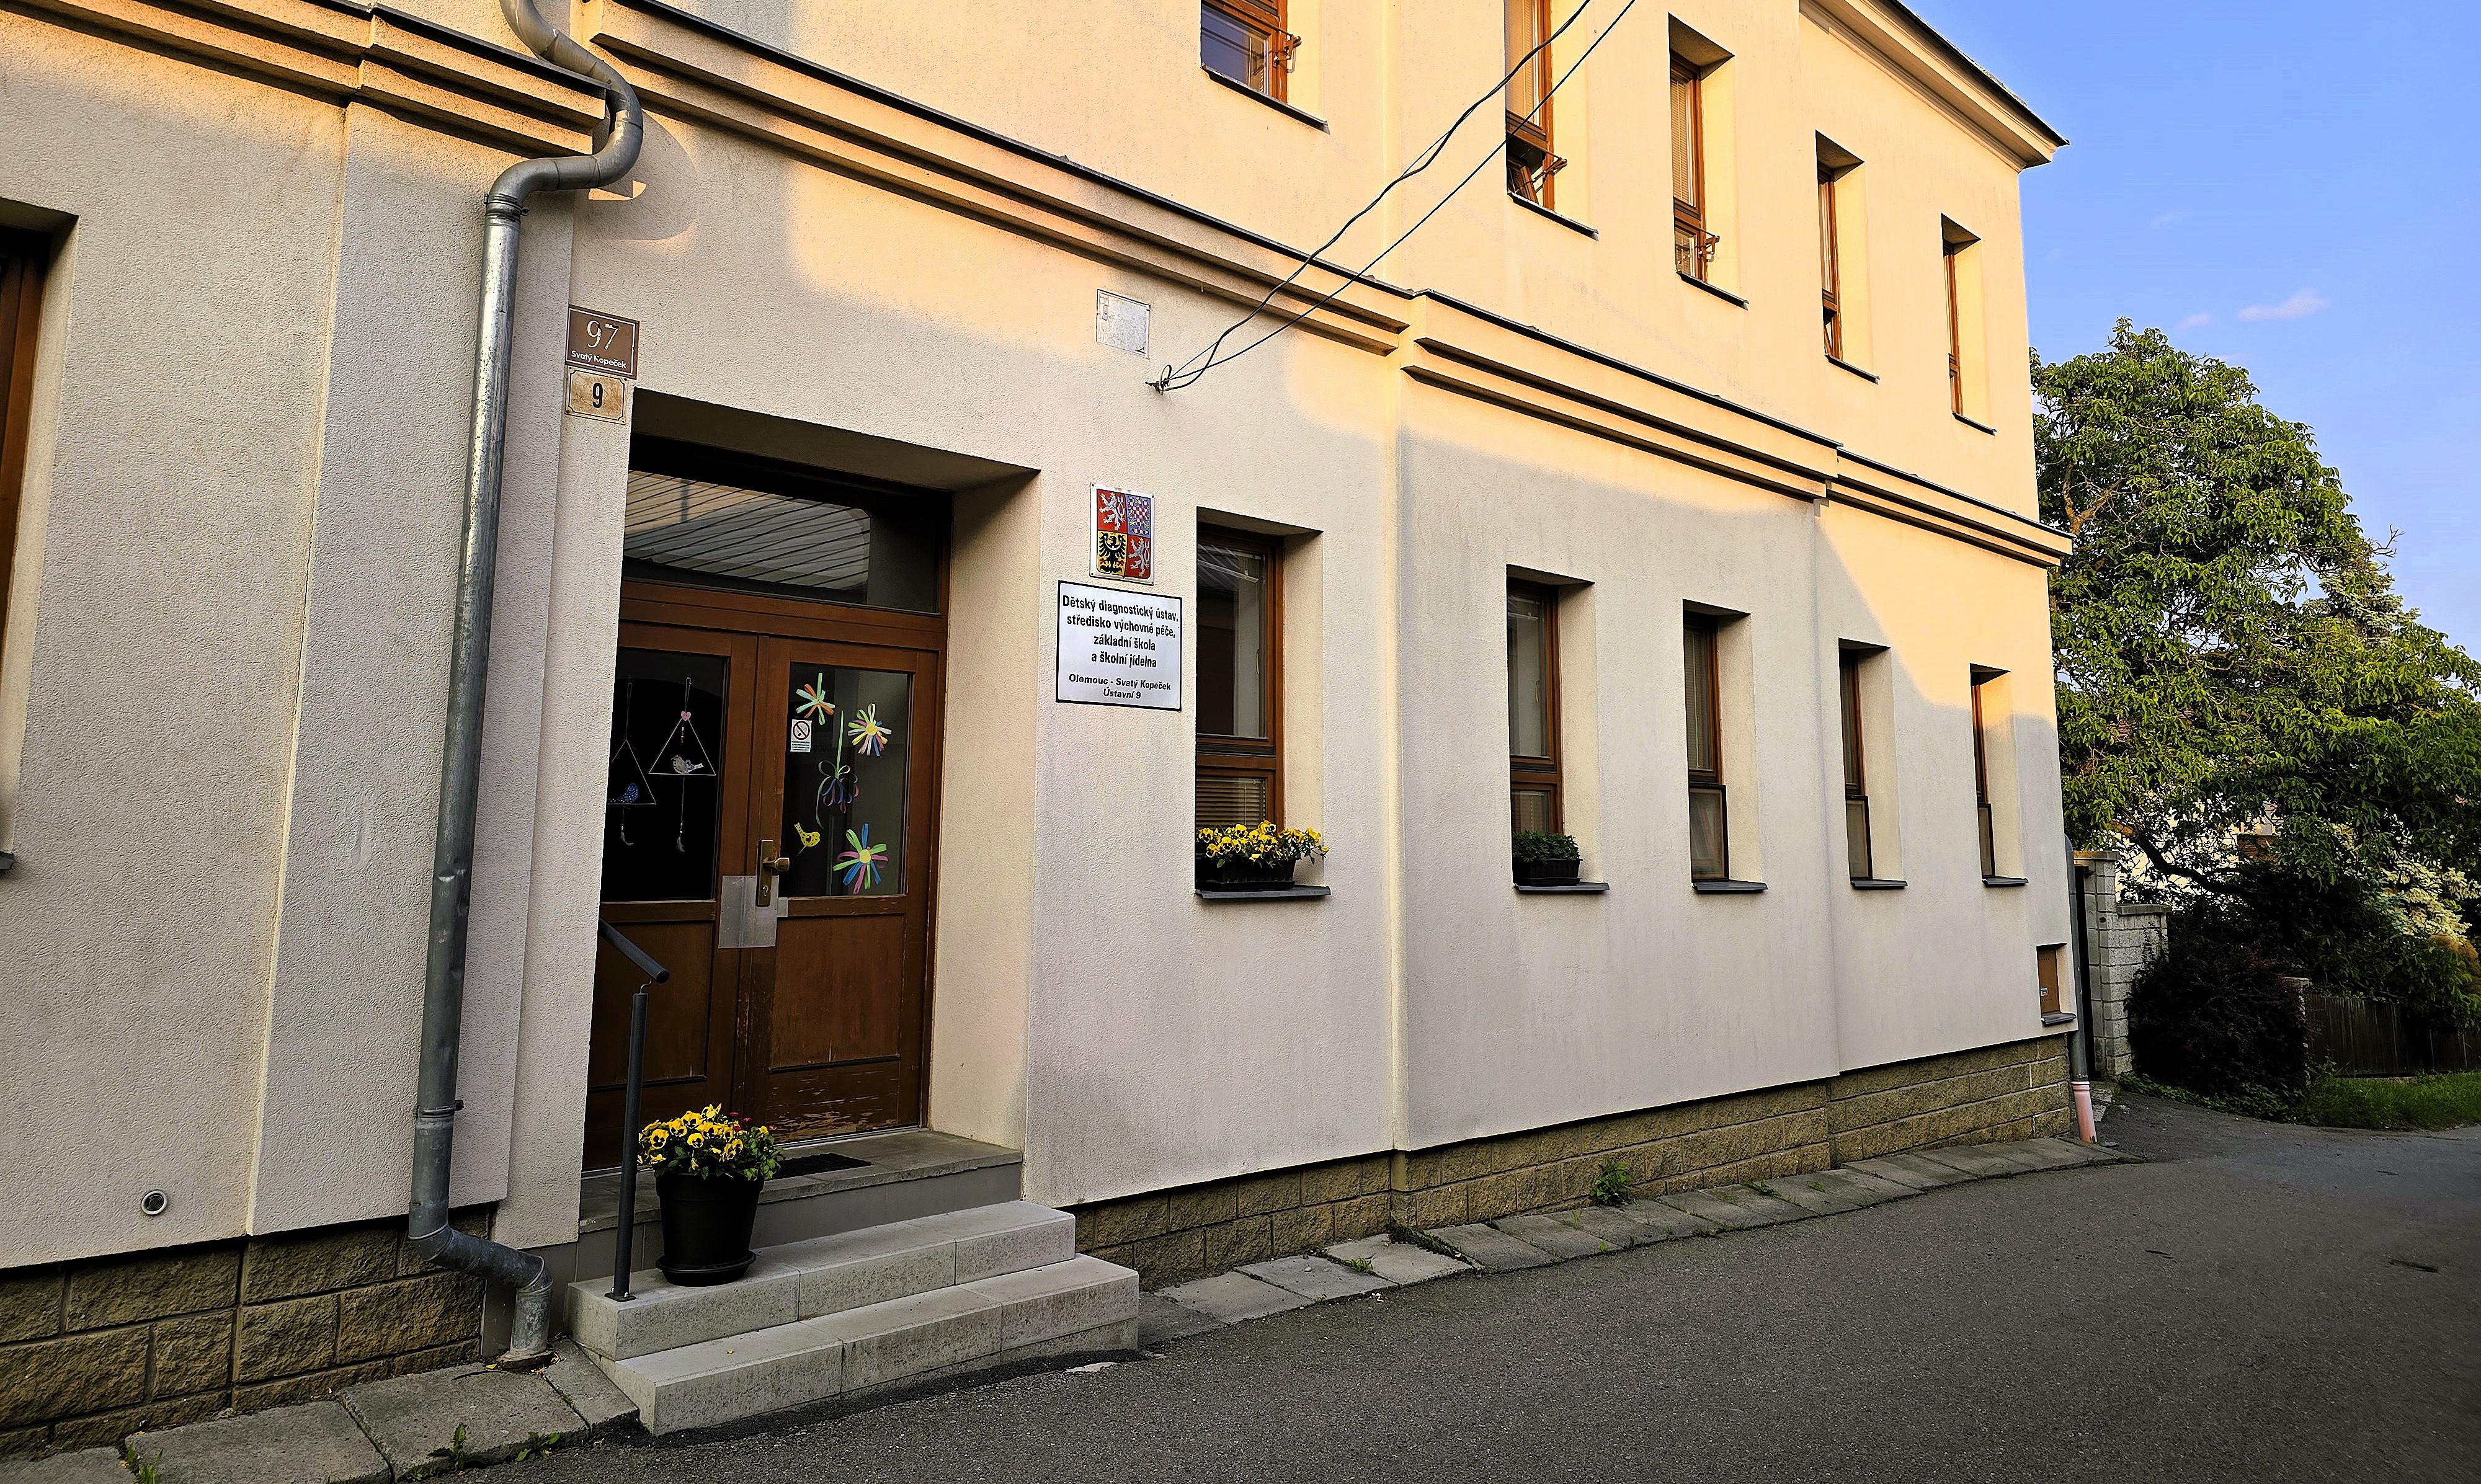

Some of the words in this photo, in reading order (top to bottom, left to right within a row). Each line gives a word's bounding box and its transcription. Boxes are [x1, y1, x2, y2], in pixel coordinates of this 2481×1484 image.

[587, 320, 619, 351] 97
[571, 350, 592, 362] Svatý
[594, 355, 626, 368] Kopeček
[592, 382, 604, 409] 9
[1062, 595, 1095, 612] Dětský
[1098, 600, 1153, 620] diagnostický
[1156, 608, 1178, 623] ústav,
[1067, 614, 1111, 628] středisko
[1114, 619, 1154, 633] výchovné
[1156, 624, 1176, 639] péče,
[1094, 633, 1133, 648] základní
[1134, 637, 1156, 651] škola
[1091, 653, 1097, 662] a
[1100, 651, 1128, 665] školní
[1129, 654, 1157, 668] jídelna
[1069, 673, 1108, 685] Olomouc
[1116, 677, 1138, 689] Svatý
[1140, 679, 1171, 690] Kopeček
[1103, 686, 1135, 698] Ústavní
[1136, 691, 1141, 699] 9
